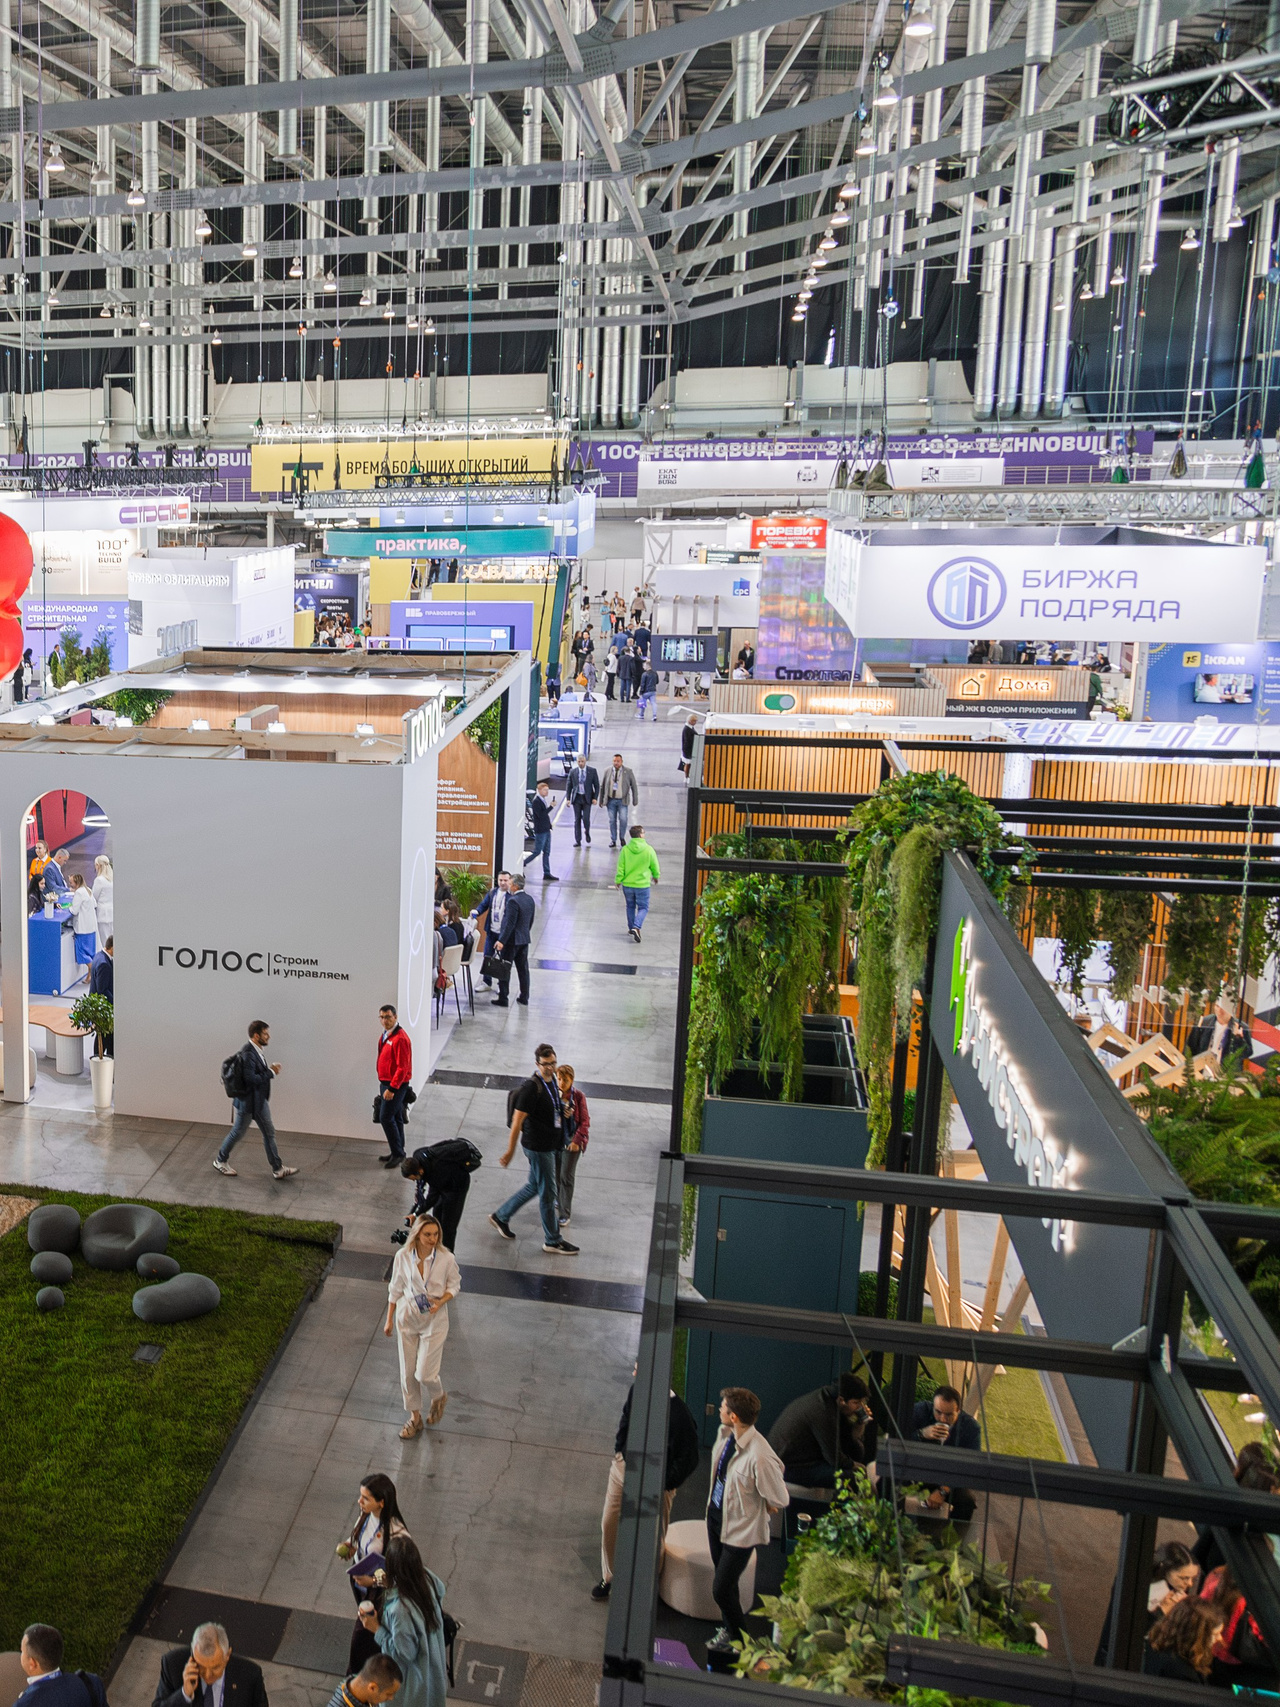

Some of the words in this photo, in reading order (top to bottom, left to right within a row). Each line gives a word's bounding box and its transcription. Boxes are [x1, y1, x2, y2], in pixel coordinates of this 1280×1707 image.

[458, 455, 529, 474] ОТКРЫТИЙ
[756, 526, 823, 536] ПОРЕВИТ
[375, 537, 468, 555] практика,
[1022, 569, 1138, 589] БИРЖА
[27, 605, 98, 614] МЕЖДУНАРОДНАЯ
[1020, 599, 1181, 622] ПОДРЯДА
[27, 614, 88, 623] СТРОИТЕЛЬНАЯ
[987, 706, 1018, 714] ОДНОМ
[1019, 706, 1077, 715] ПРИЛОЖЕНИИ
[452, 844, 482, 852] AWARDS
[158, 945, 265, 974] ГОЛОС
[273, 953, 319, 967] Строим
[283, 970, 350, 982] управляем
